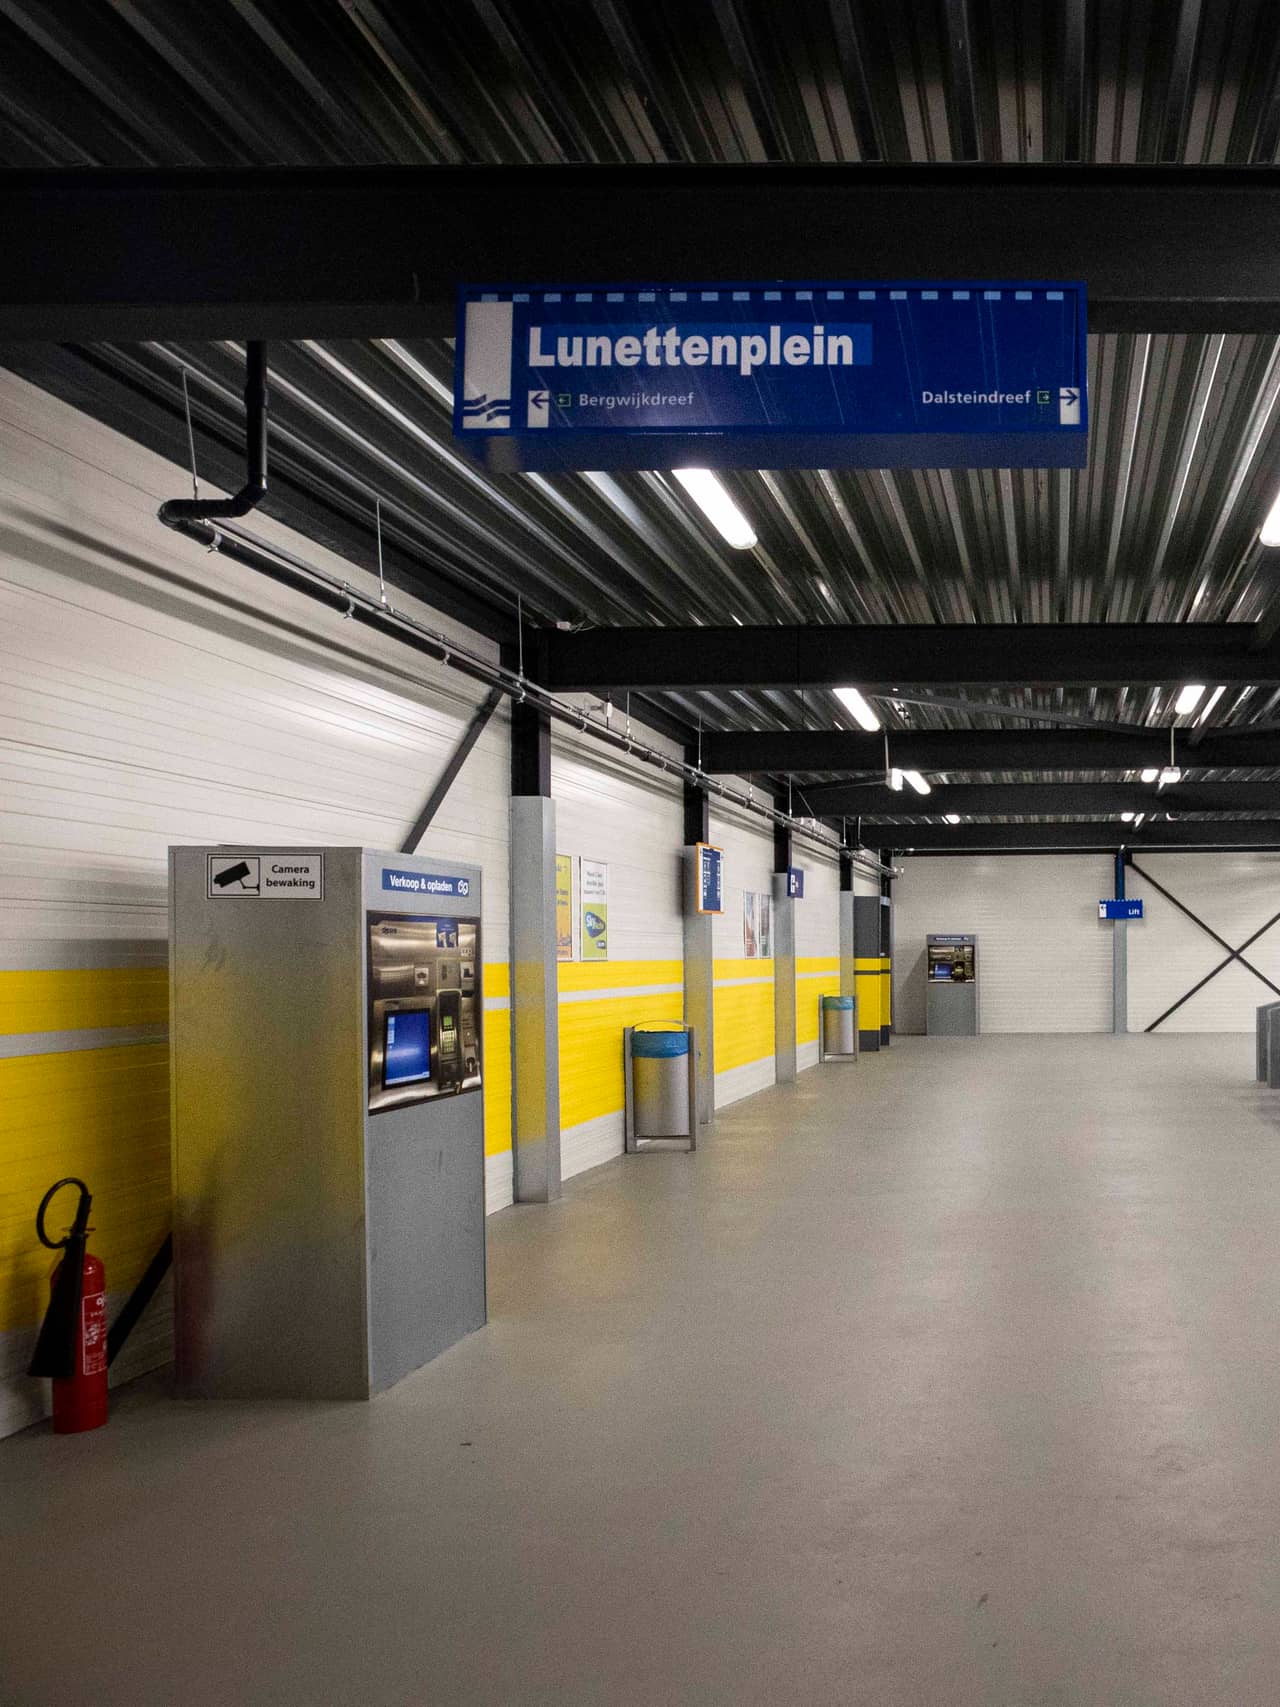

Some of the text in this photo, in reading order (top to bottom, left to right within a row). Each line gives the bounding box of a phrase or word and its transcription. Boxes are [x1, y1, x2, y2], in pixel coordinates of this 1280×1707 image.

[527, 325, 854, 376] Lunettenplein
[578, 390, 694, 409] Bergwijkdreef
[921, 389, 1032, 405] Dalsteindreef
[271, 864, 310, 875] Camera
[266, 877, 315, 889] bewaking
[390, 874, 453, 893] Verkoop & opladen
